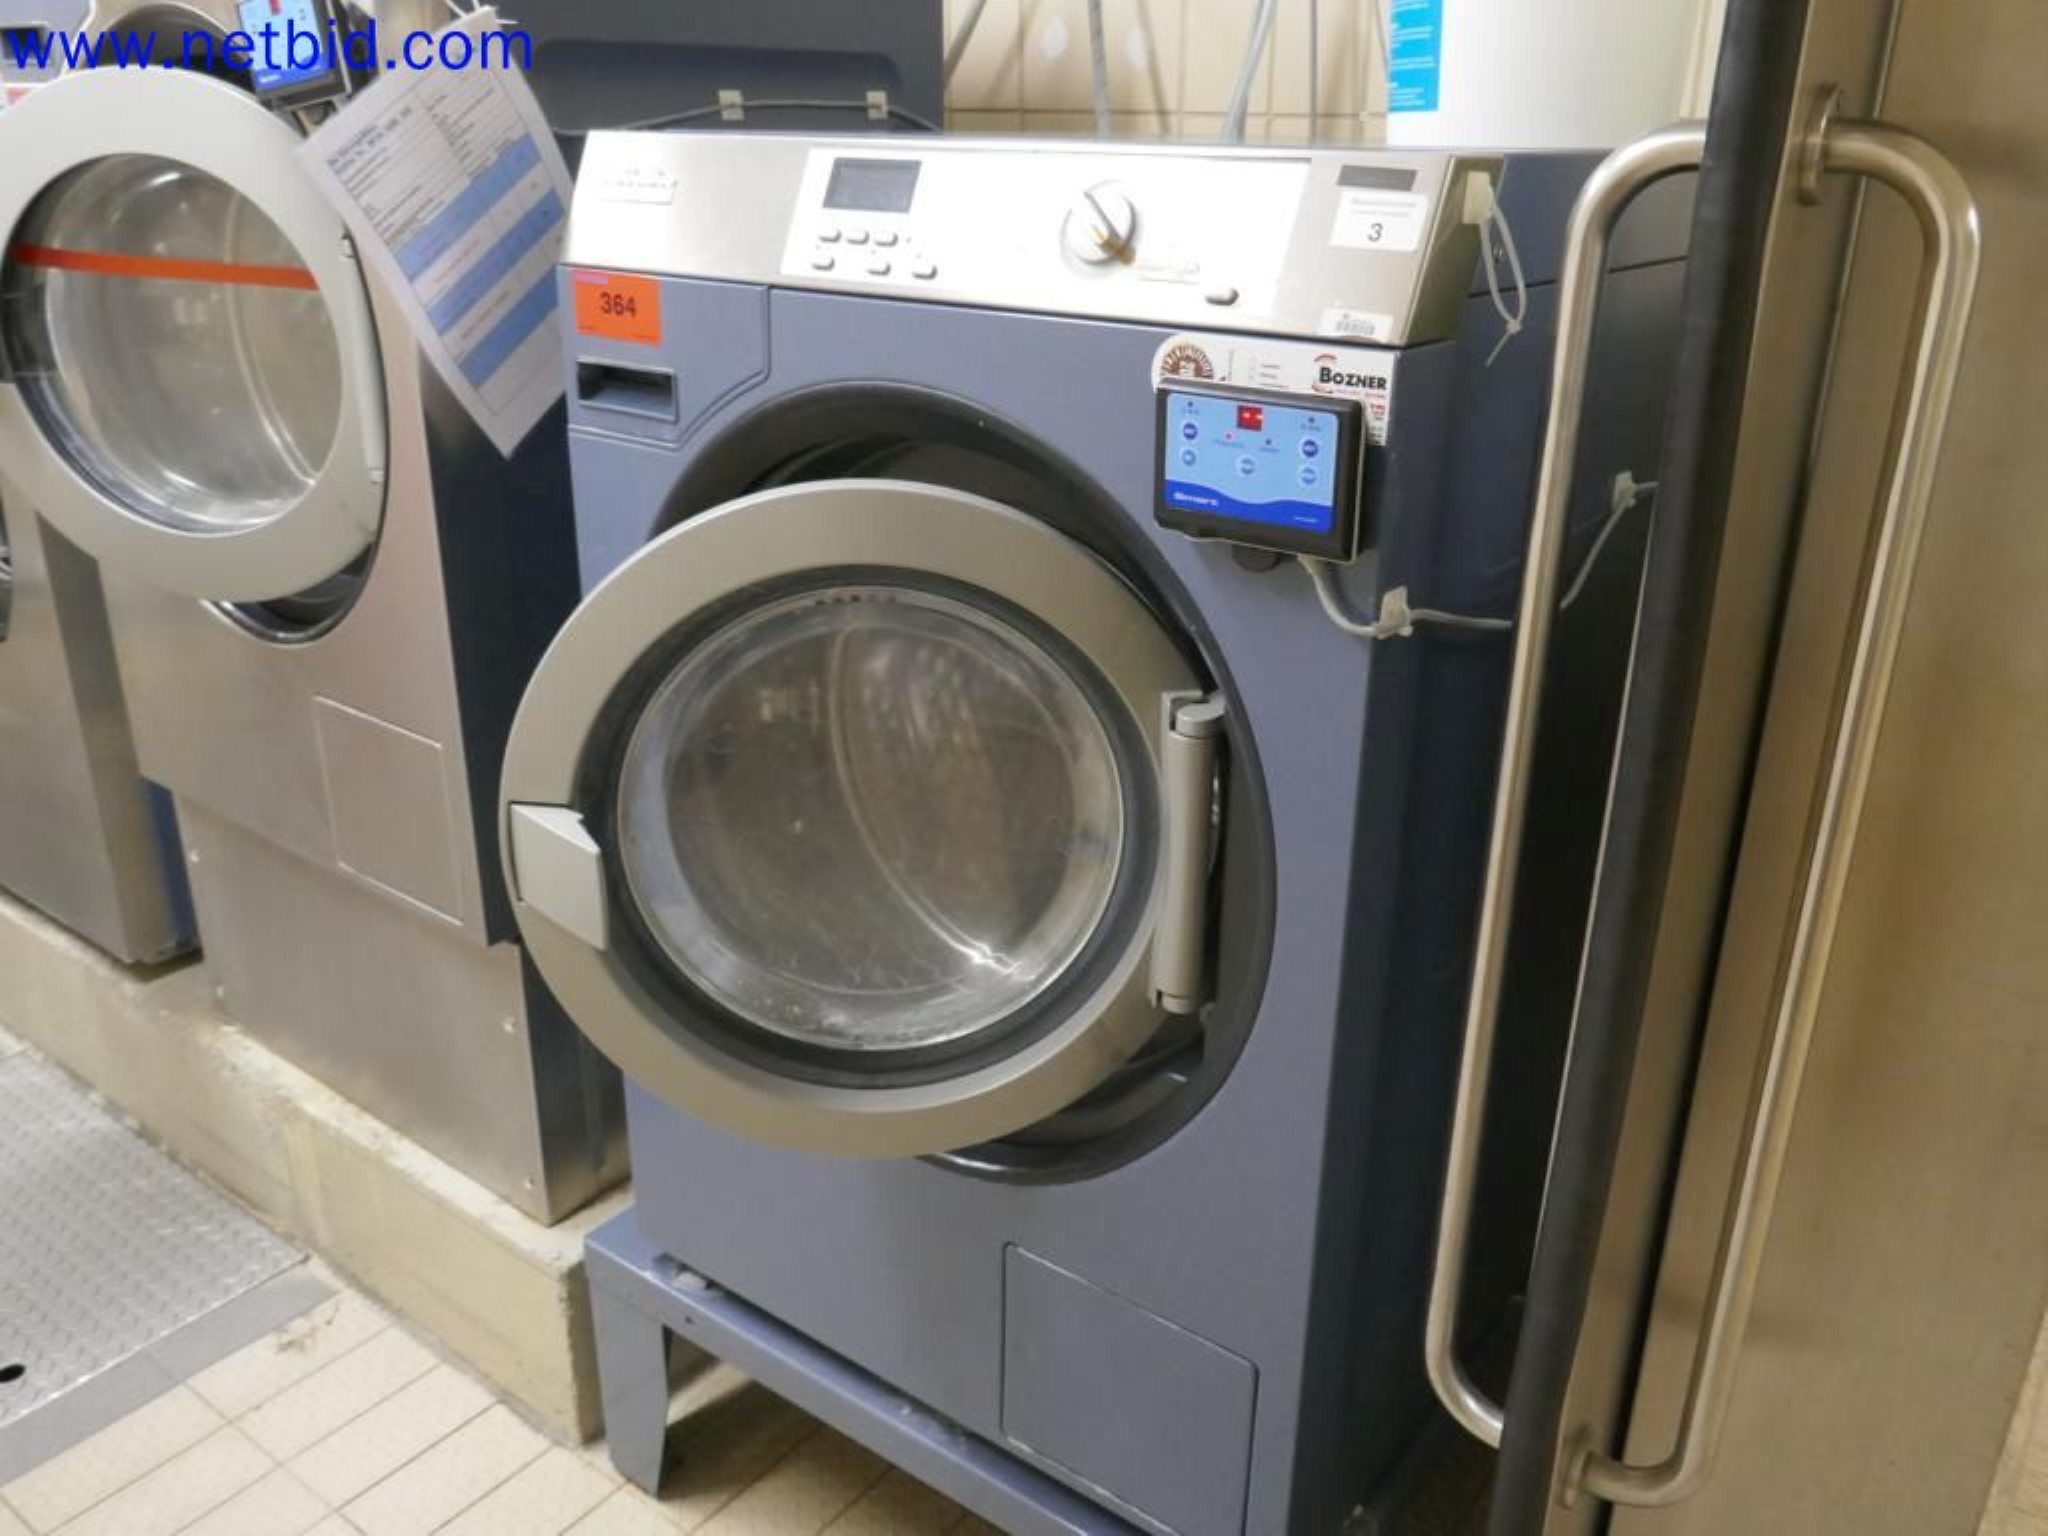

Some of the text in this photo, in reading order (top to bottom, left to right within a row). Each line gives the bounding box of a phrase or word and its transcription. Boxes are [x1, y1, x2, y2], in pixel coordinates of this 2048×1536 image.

[1367, 222, 1383, 242] 3
[600, 291, 637, 318] 364
[1319, 366, 1387, 390] BOZNER
